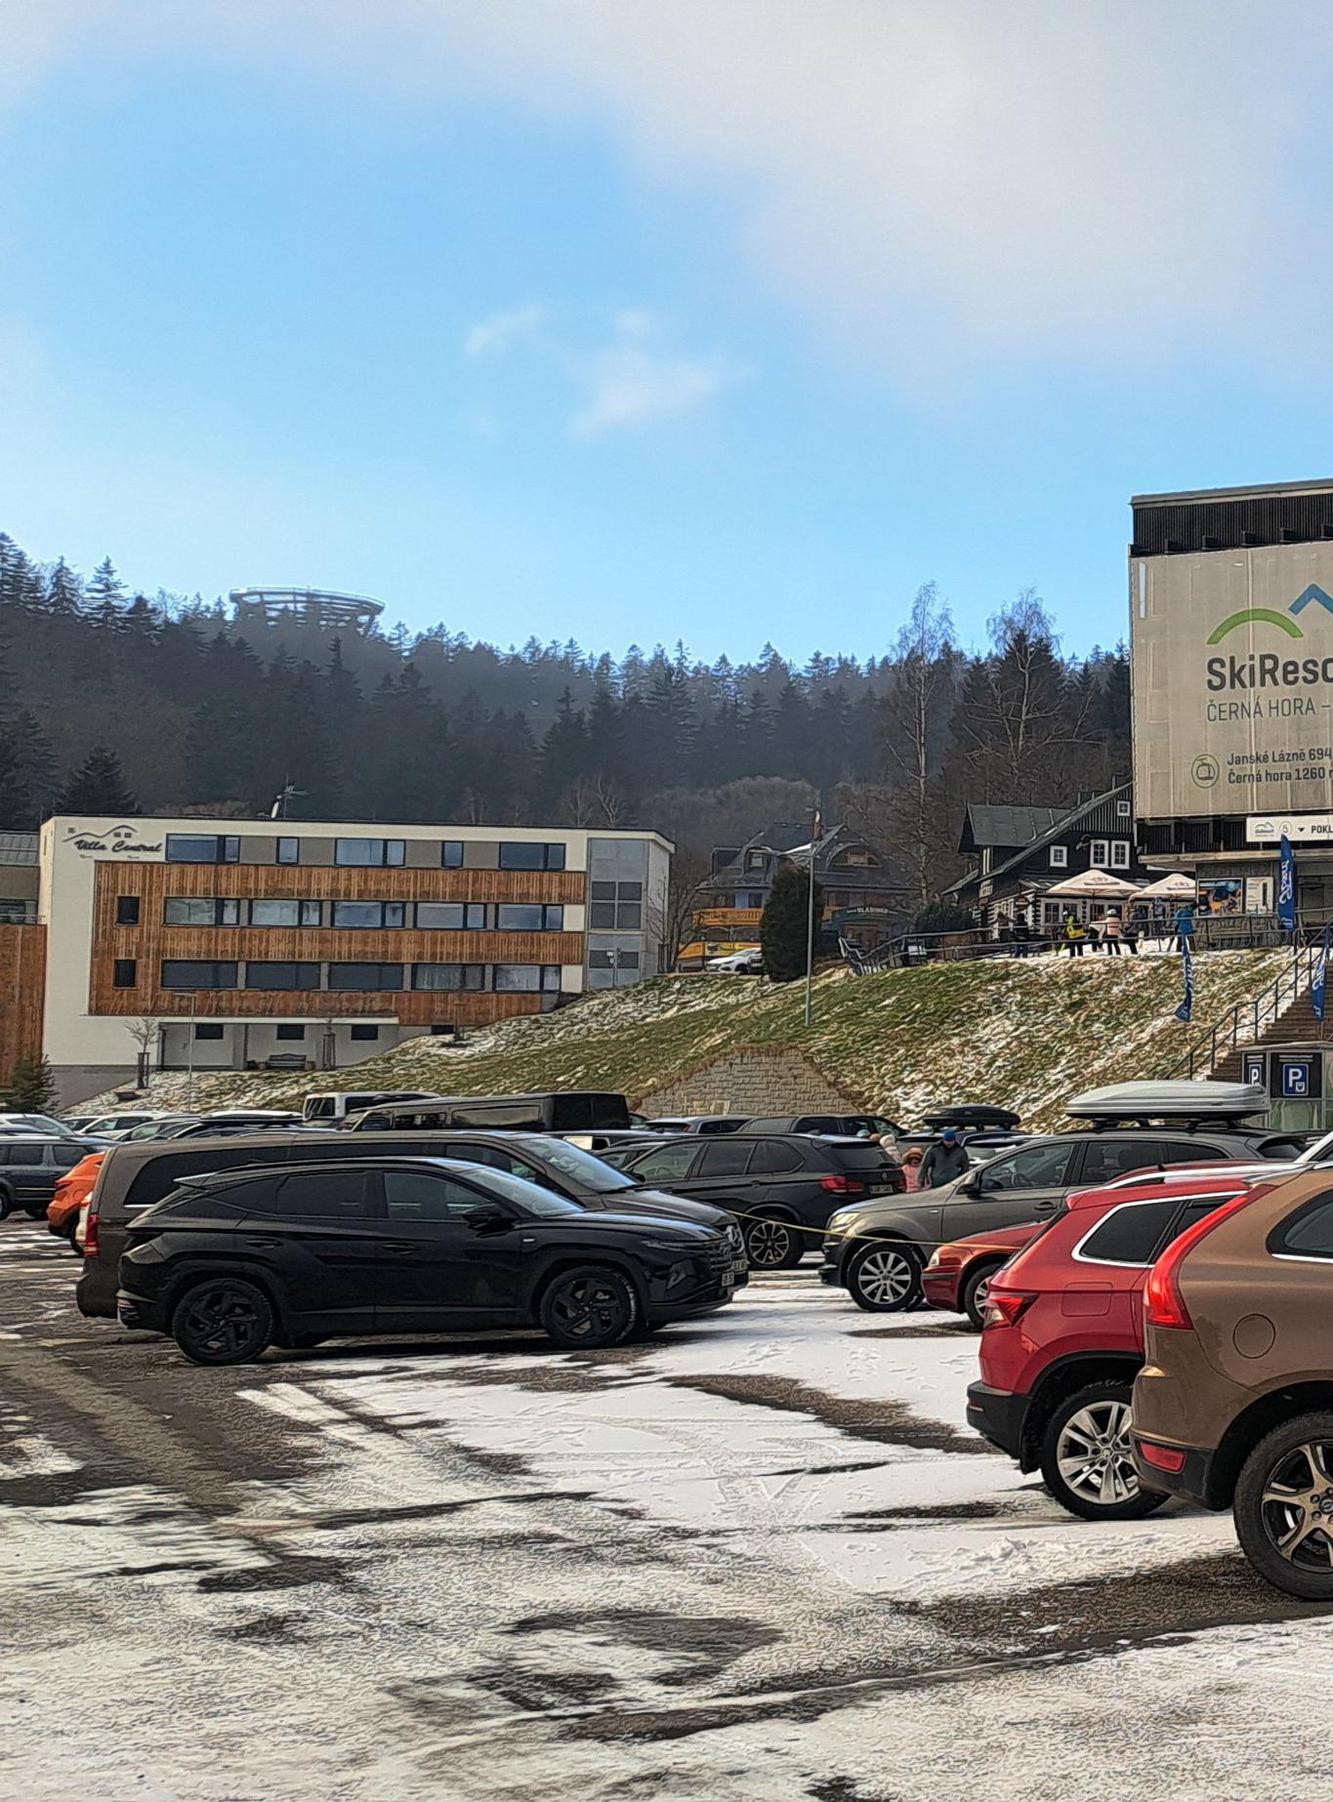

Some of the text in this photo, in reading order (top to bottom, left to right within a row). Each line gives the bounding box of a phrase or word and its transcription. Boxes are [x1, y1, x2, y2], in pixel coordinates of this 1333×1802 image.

[1207, 696, 1264, 722] ČERNÁ
[1268, 697, 1316, 718] HORA
[1227, 750, 1269, 766] Janské
[1272, 748, 1306, 763] Lázně
[1308, 748, 1332, 761] 694
[1228, 768, 1262, 784] Černá
[1265, 768, 1292, 782] hora
[1295, 766, 1326, 781] 1260
[74, 839, 163, 852] Villa Central
[1251, 1068, 1259, 1085] P
[1288, 1068, 1302, 1088] P
